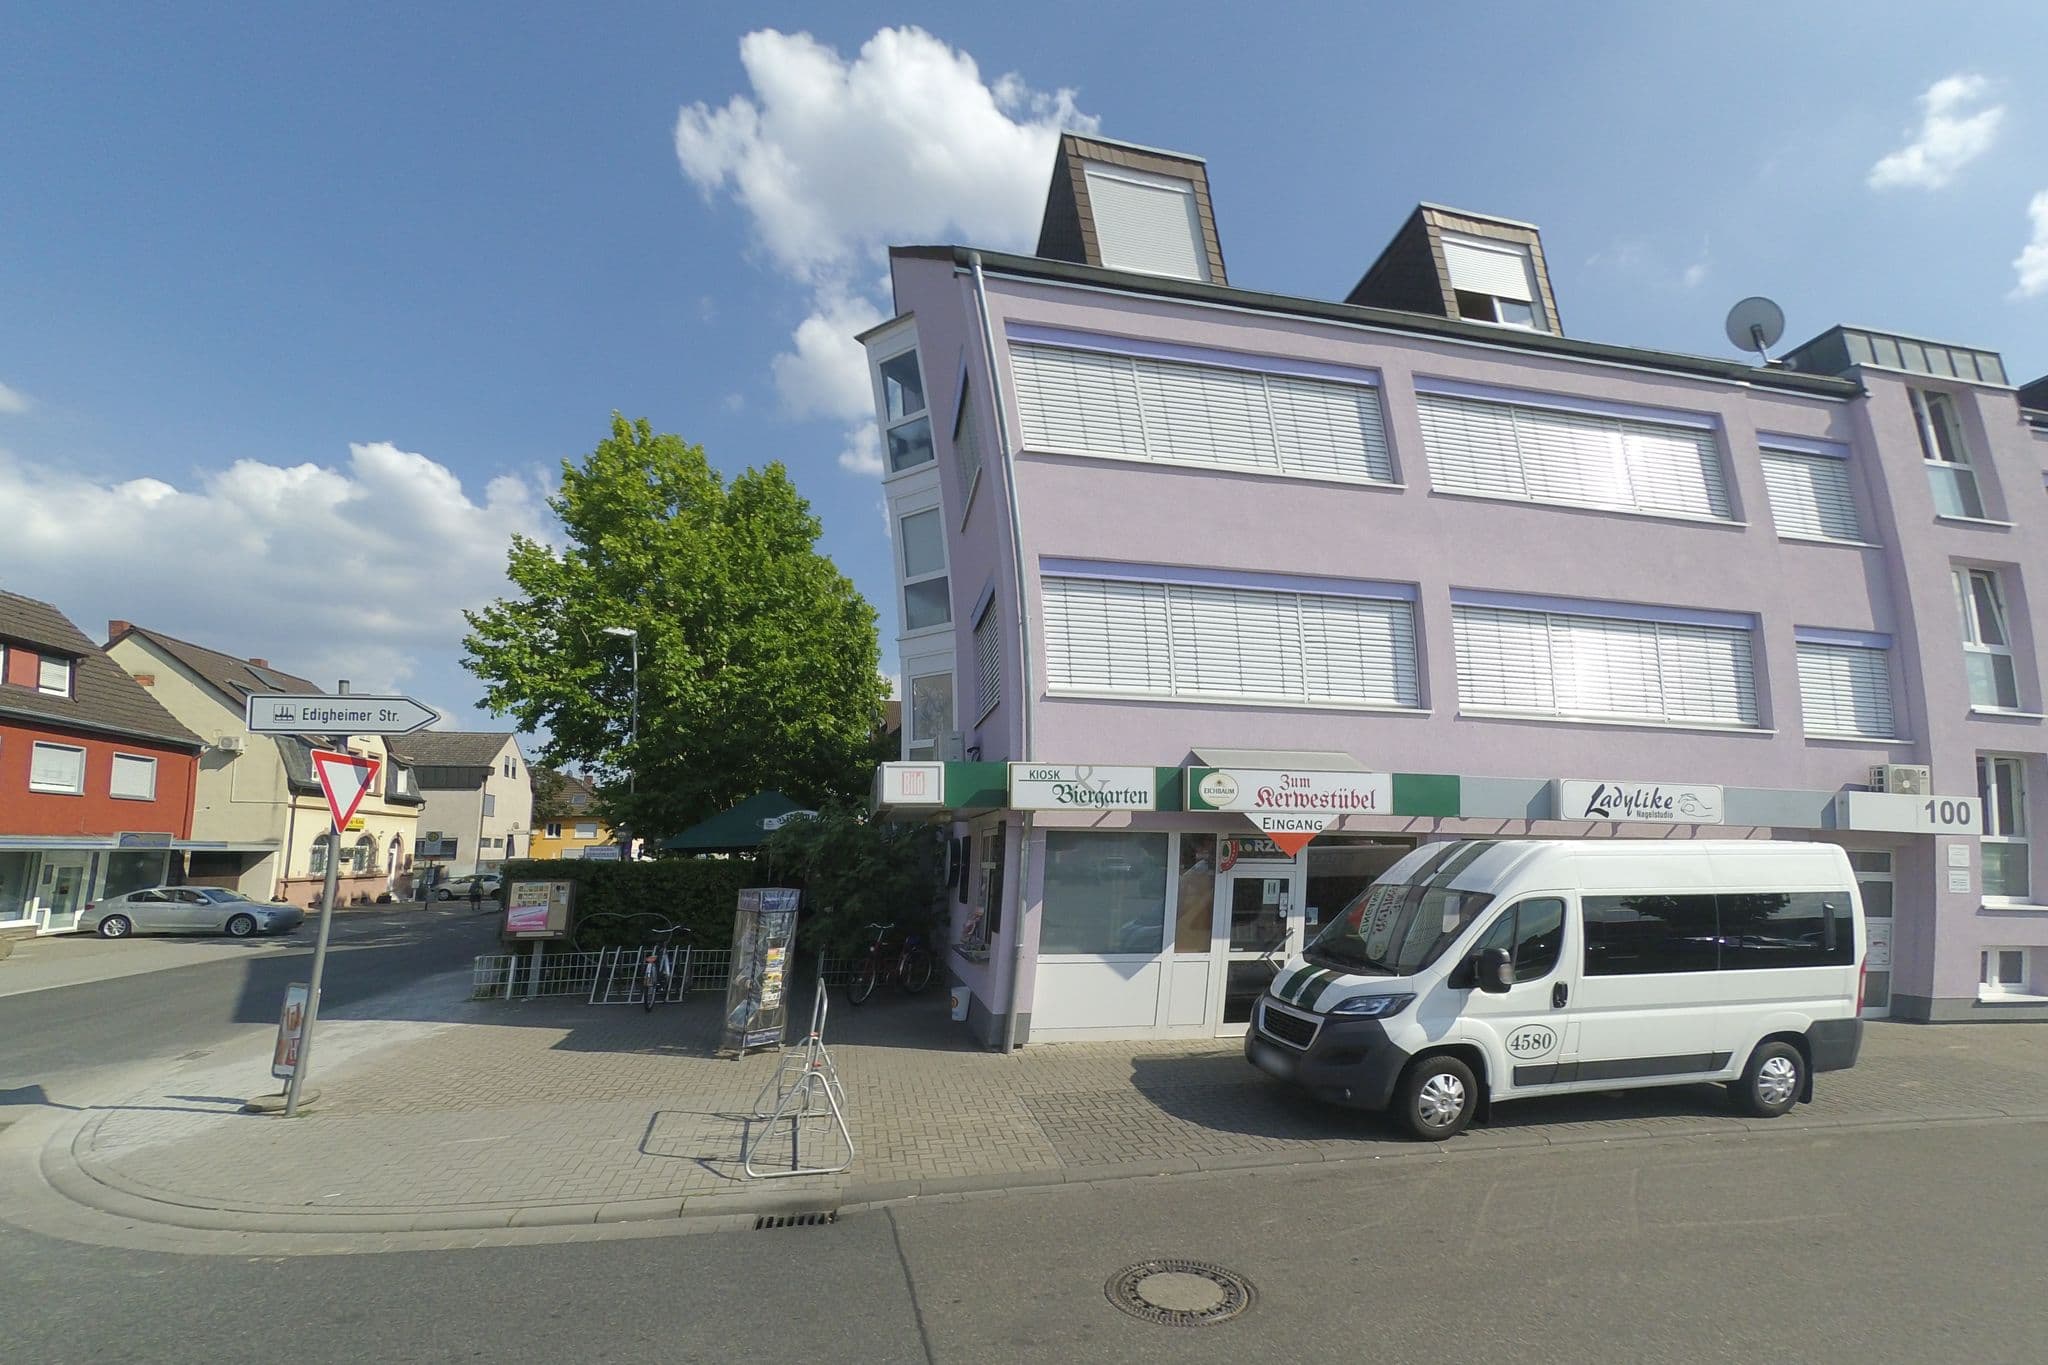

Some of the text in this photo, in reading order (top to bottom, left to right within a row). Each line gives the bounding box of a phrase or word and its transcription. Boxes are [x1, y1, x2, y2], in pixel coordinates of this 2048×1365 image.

[302, 708, 400, 723] Edigheimer Str.
[903, 771, 925, 795] Bild
[1029, 769, 1060, 780] KIOSK
[1279, 774, 1311, 790] Zum
[1052, 783, 1148, 808] Biergarten
[1254, 785, 1376, 810] Kerwestübel
[1584, 784, 1674, 818] Ladylike
[1636, 810, 1674, 819] Nagelstudio
[1924, 800, 1971, 825] 100
[1262, 817, 1323, 831] EINGANG
[1511, 1033, 1551, 1050] 4580
